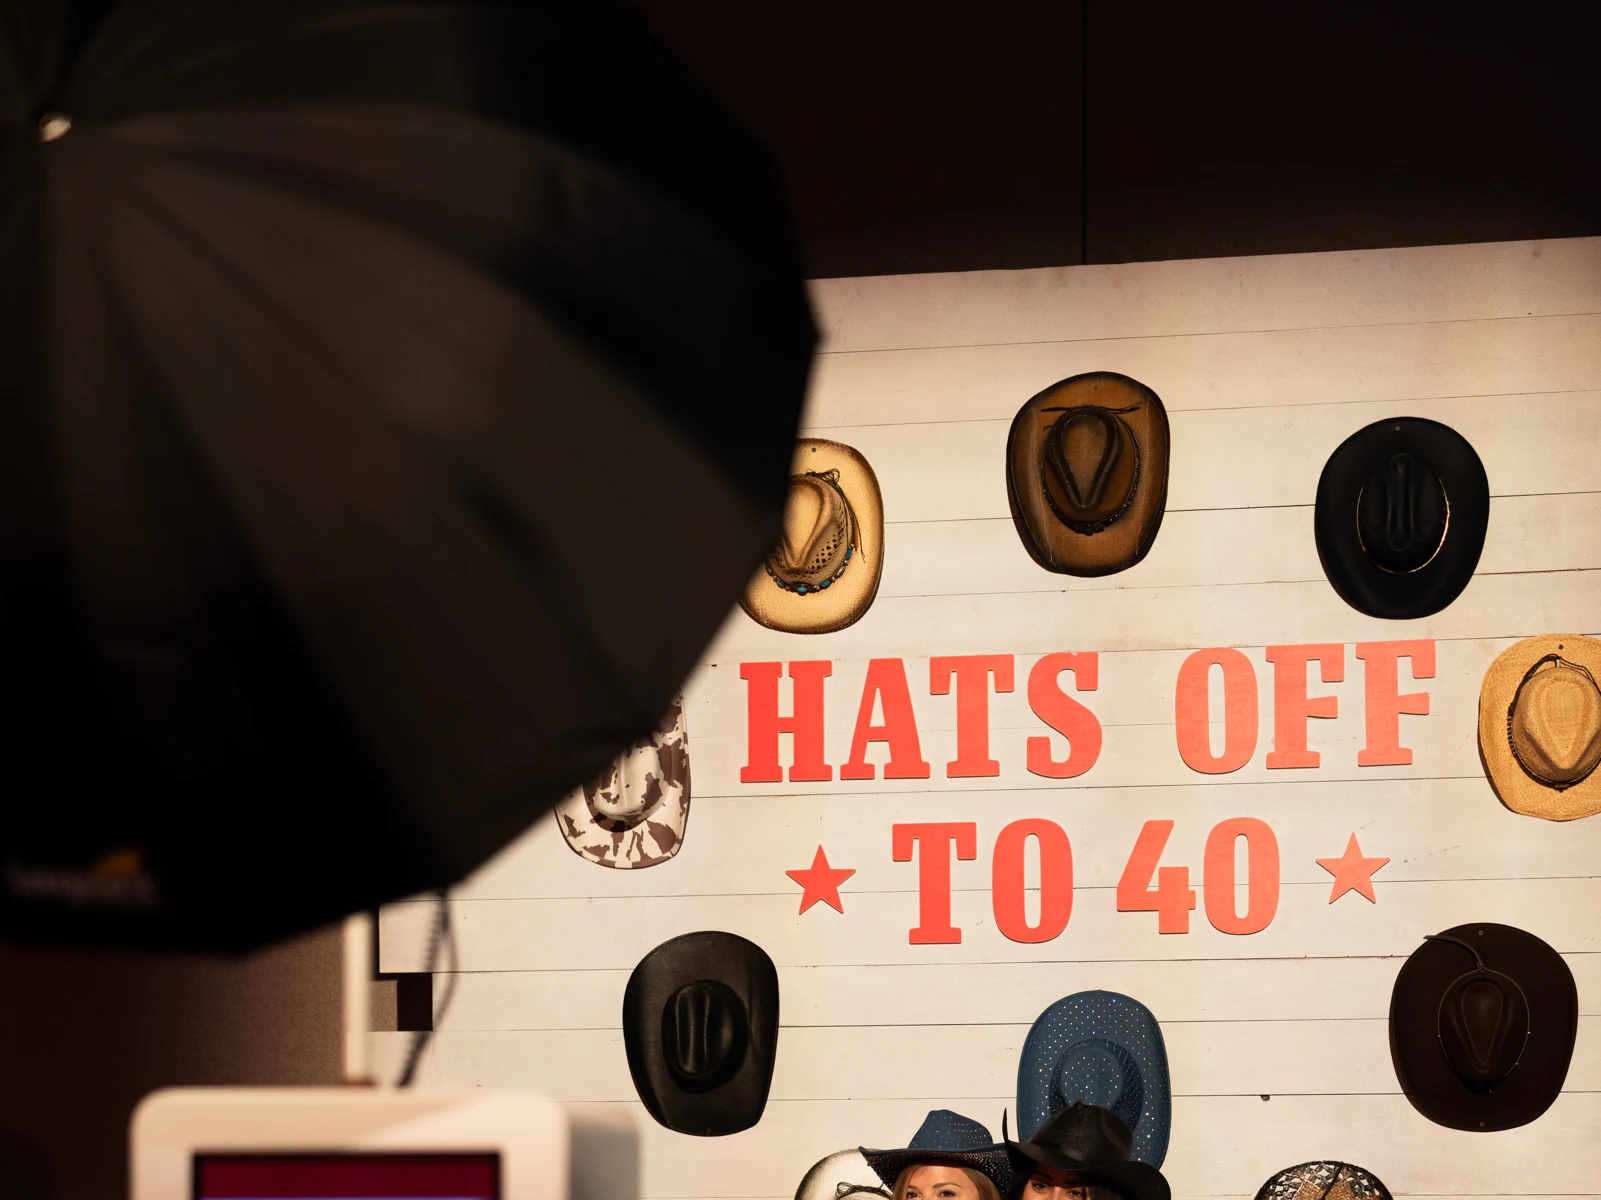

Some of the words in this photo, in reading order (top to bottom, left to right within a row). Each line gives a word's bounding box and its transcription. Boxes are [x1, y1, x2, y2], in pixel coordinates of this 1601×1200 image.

[740, 653, 1103, 782] HATS
[1176, 639, 1437, 773] OFF
[892, 818, 1073, 943] TO
[1116, 818, 1280, 935] 40
